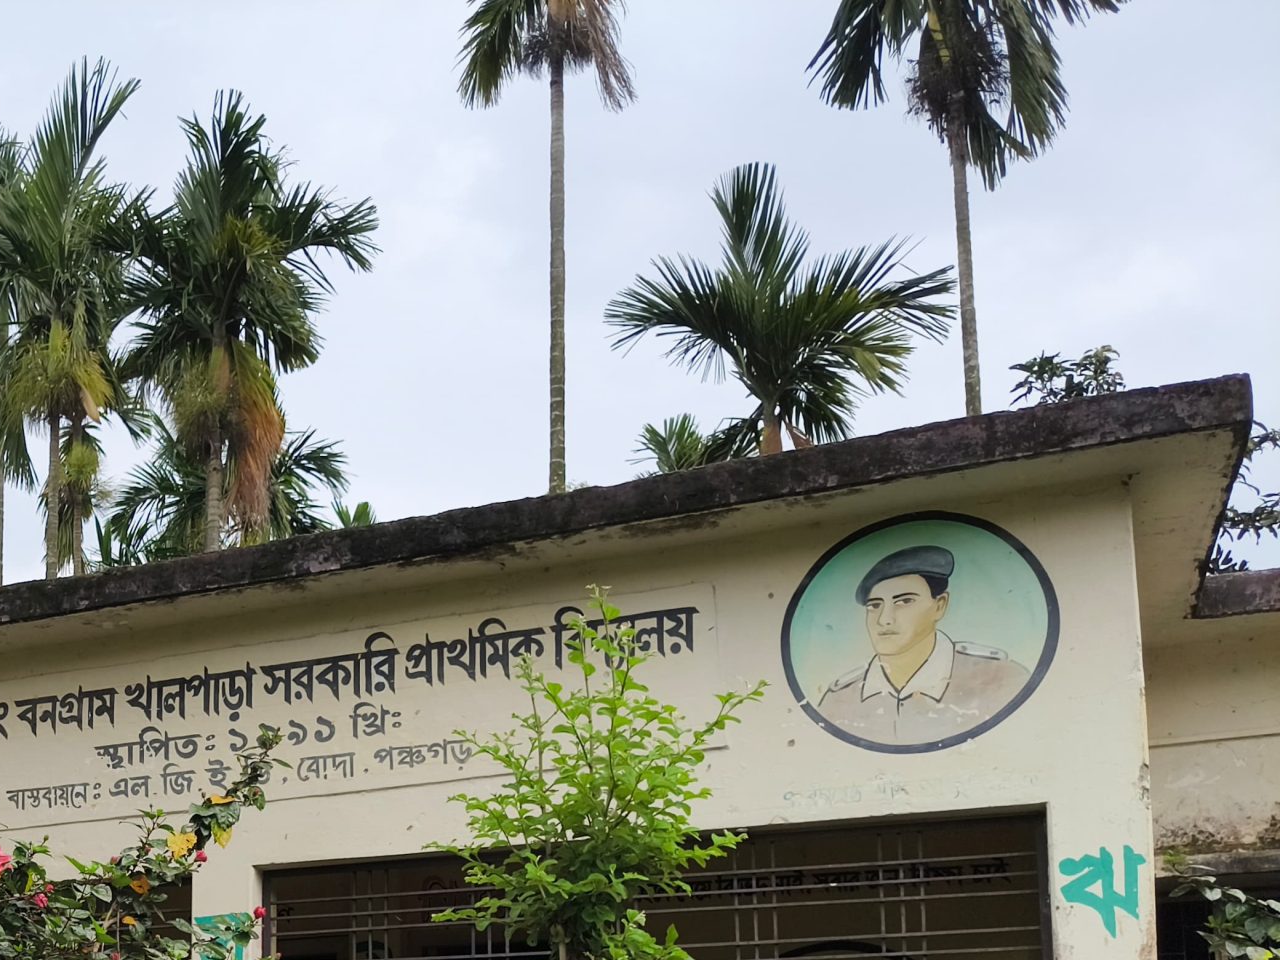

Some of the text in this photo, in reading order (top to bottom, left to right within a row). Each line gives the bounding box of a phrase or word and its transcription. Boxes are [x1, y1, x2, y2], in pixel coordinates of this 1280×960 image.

[15, 685, 119, 738] বনগ্রাম
[124, 661, 257, 723] খালপাড়া
[260, 631, 401, 705] সরকারি
[405, 617, 546, 686] প্রাথমিক
